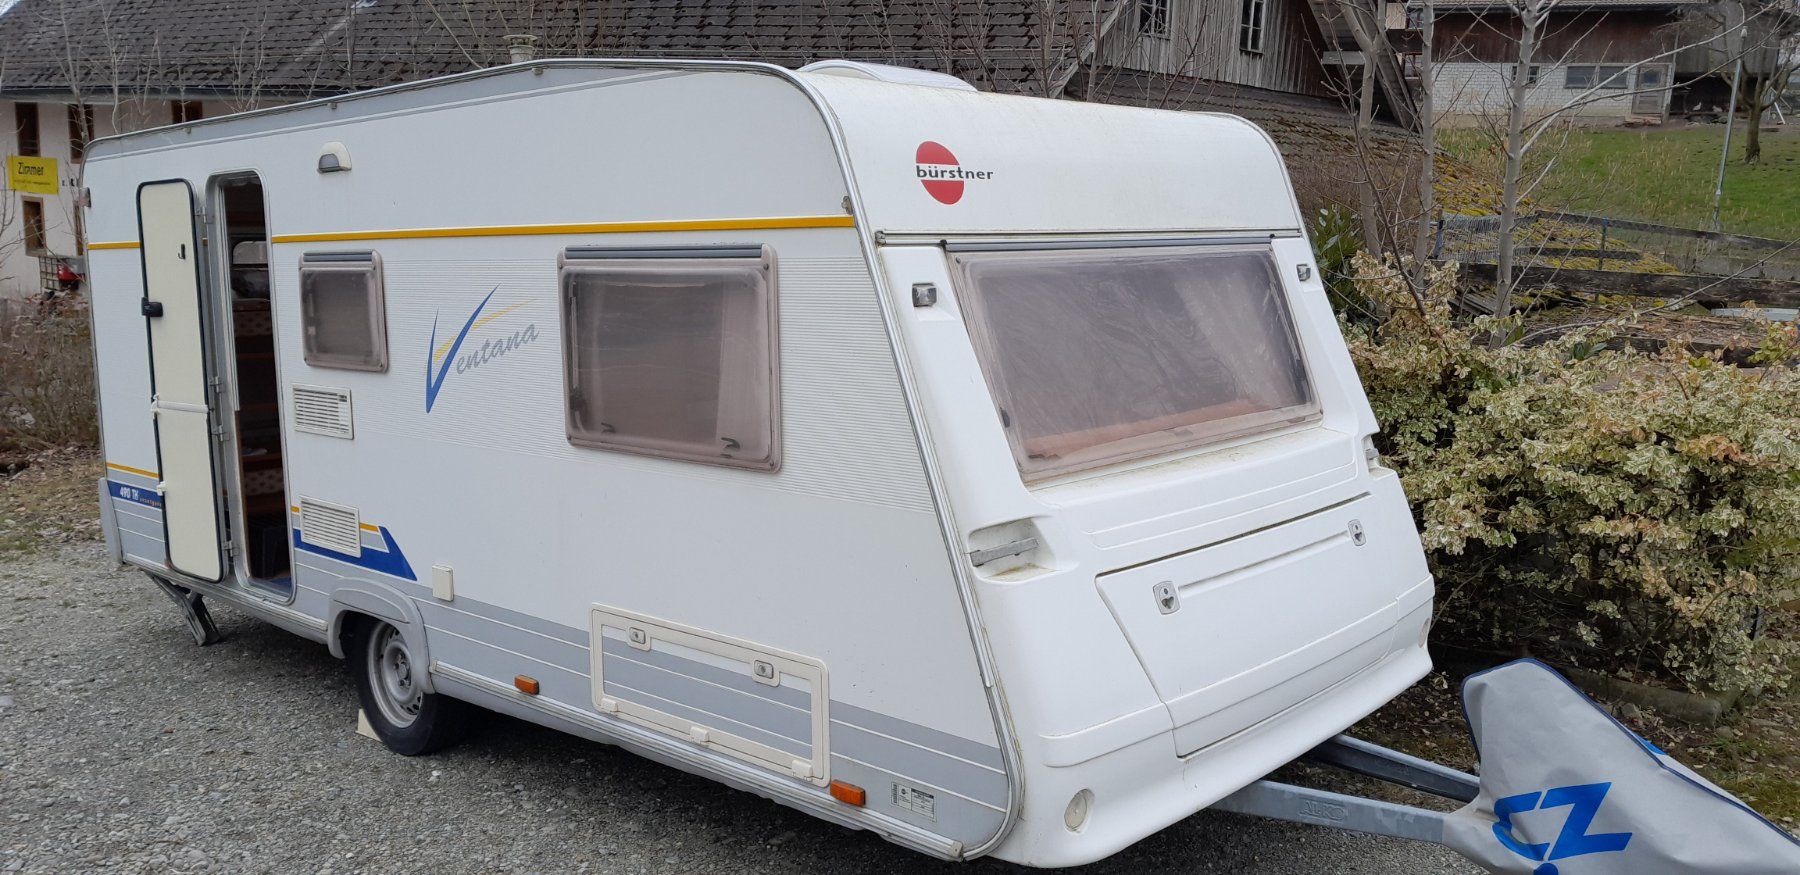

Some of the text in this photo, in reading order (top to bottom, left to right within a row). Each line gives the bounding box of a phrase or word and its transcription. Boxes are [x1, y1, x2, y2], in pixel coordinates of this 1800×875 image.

[18, 162, 44, 176] Zimmer
[916, 165, 994, 180] bürstner
[426, 282, 540, 413] Ventana
[120, 486, 131, 498] 490
